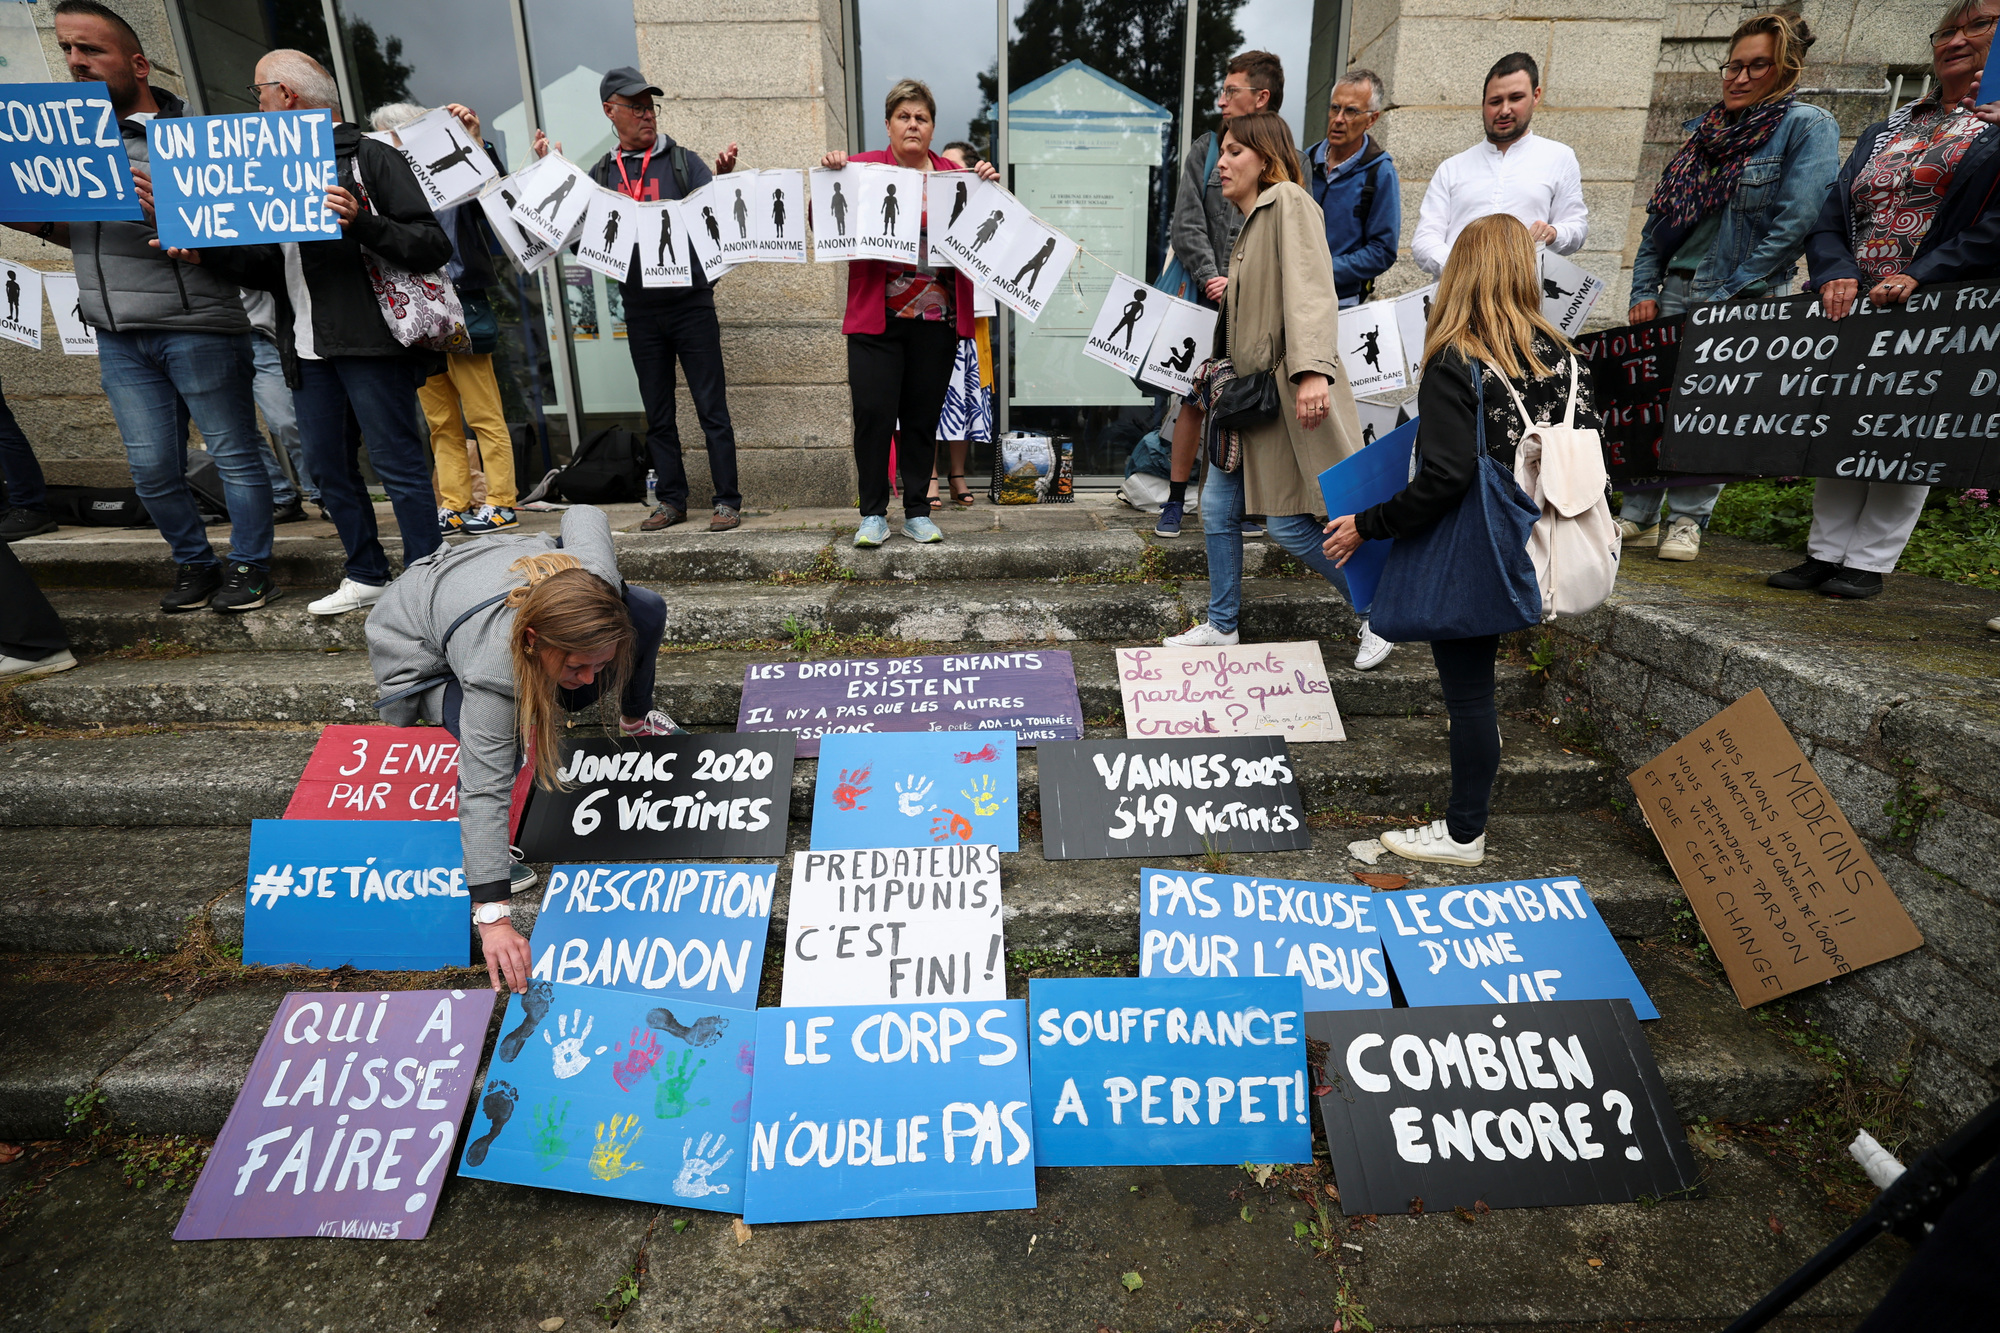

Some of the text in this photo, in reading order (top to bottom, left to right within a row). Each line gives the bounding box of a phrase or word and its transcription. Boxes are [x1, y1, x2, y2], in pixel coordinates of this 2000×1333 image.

[0, 99, 119, 148] COUTEZ
[154, 114, 325, 159] UN ENFANT
[11, 155, 125, 200] NOUS!
[282, 160, 336, 196] UNE
[401, 149, 446, 204] ANONYME
[178, 191, 338, 239] VIE VOLÉE
[518, 203, 564, 240] ANONYME
[521, 241, 548, 263] ANONY
[581, 246, 627, 272] ANONYME
[759, 240, 804, 251] ANONYME
[860, 236, 916, 252] ANONYME
[945, 235, 992, 277] ANONYME
[644, 266, 689, 276] ANONYME
[992, 275, 1042, 312] ANONYME
[1560, 275, 1596, 331] ANONYME
[1692, 301, 1792, 326] CHAQUE
[1905, 291, 1941, 313] EN
[1955, 286, 2000, 312] FRA
[0, 318, 39, 339] ONYME
[65, 337, 95, 345] SOLENNE
[1867, 323, 2000, 357] ENFAN
[1088, 336, 1141, 366] ANONYME
[1148, 363, 1174, 378] SOPHIE
[1622, 355, 1660, 385] TE
[1350, 370, 1403, 388] ANDRINE 6ANS
[1680, 371, 1764, 396] SONT
[1852, 413, 2000, 440] SEXUELLE
[750, 664, 785, 680] LES
[887, 658, 924, 676] DES
[943, 653, 1043, 672] ENFANTS
[1124, 650, 1285, 687] Les enfants
[745, 707, 774, 724] IL
[815, 707, 828, 719] A
[836, 705, 868, 718] PAS
[873, 702, 903, 715] QUE
[911, 701, 939, 714] LES
[953, 697, 1025, 711] AUTRES
[1128, 669, 1330, 713] parlent qui les
[1025, 714, 1073, 726] TOURNÉE
[339, 738, 459, 777] 3 ENFA
[556, 748, 774, 784] JONZAC 2020
[1092, 752, 1293, 791] VANNES 2025
[327, 782, 457, 812] PAR CLA
[572, 788, 610, 836] 6
[1716, 728, 1743, 766] NOUS
[1741, 770, 1780, 822] AVONS
[1777, 830, 1826, 898] HONTE
[1668, 772, 1736, 877] AUX VICTIMES
[1773, 763, 1874, 895] MEDECINS
[804, 845, 999, 882] PREDATEURS
[1676, 755, 1809, 964] NOUS DEMANDONS PARDON
[1699, 738, 1715, 754] DE
[1711, 759, 1762, 832] L'INACTION
[1808, 919, 1851, 974] L'ORDRE
[839, 880, 999, 918] IMPUNIS,
[1644, 770, 1783, 991] ET QUE CELA CHANGE
[1148, 873, 1377, 933] PAS D'EXCUSE
[1385, 881, 1587, 936] LE COMBAT
[795, 922, 906, 961] C'EST
[1417, 931, 1524, 975] D'UNE
[531, 936, 752, 993] ABANDON
[1140, 929, 1390, 997] POUR L'ABUS
[784, 1007, 1018, 1066] LE CORPS
[1038, 1006, 1299, 1047] SOUFFRANCE
[1052, 1070, 1308, 1127] A PERPET!
[751, 1100, 1031, 1172] N'OUBLIE PAS
[340, 1218, 403, 1239] VANNES
